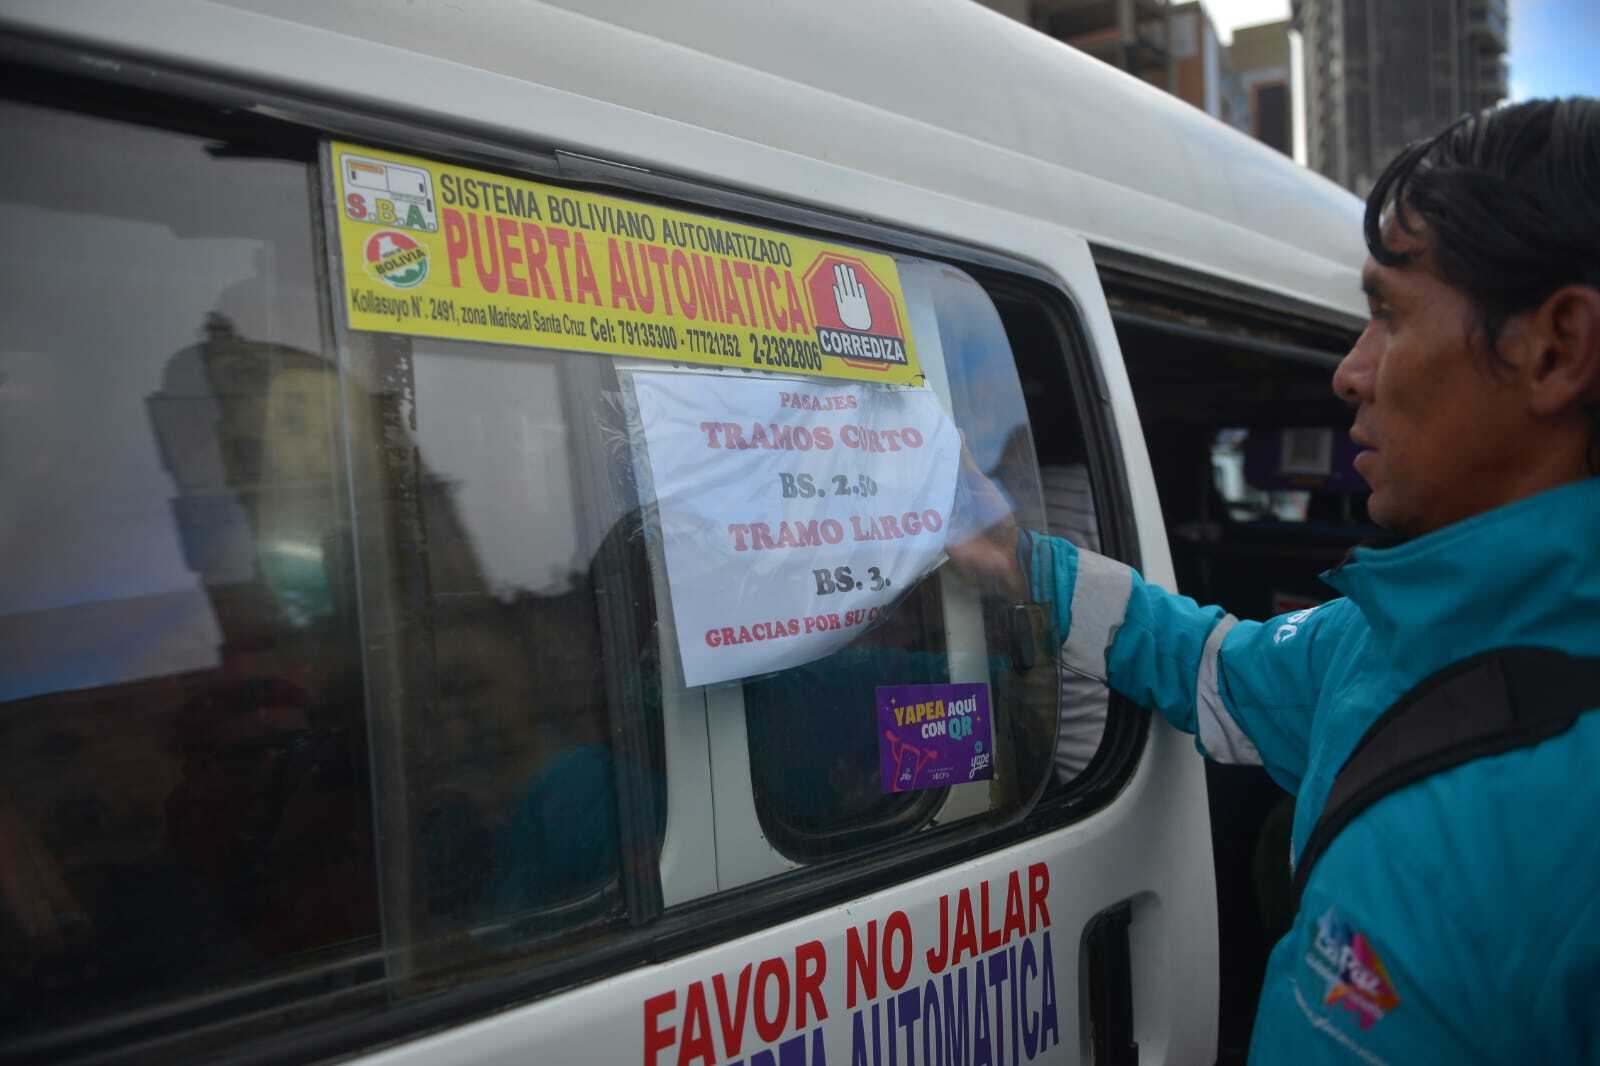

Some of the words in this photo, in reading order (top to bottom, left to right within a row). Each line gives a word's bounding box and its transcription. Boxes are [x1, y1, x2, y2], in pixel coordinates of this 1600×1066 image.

[440, 173, 542, 221] SISTEMA
[546, 194, 655, 241] BOLIVIANO
[662, 218, 793, 268] AUTOMATIZADO
[375, 248, 426, 274] BOLIVIA
[442, 207, 602, 307] PUERTA
[607, 236, 809, 336] AUTOMATICA
[461, 306, 487, 326] zona
[488, 304, 532, 331] Mariscal
[532, 310, 562, 334] Santa
[562, 313, 587, 337] Cruz
[590, 316, 617, 344] Cel:
[618, 319, 678, 351] 79135300
[686, 328, 742, 358] 77721252
[749, 333, 822, 371] 2-2382806
[820, 329, 906, 362] CORREDIZA
[778, 391, 858, 411] PASAJES
[700, 421, 834, 452] TRAMOS
[840, 424, 924, 453] CORTO
[779, 472, 826, 499] BS.
[728, 518, 844, 552] TRAMO
[849, 508, 943, 542] LARGO
[812, 566, 863, 596] BS.
[705, 618, 800, 648] GRACIAS
[803, 612, 841, 634] POR
[844, 608, 866, 628] SU
[894, 700, 945, 726] YAPEA
[947, 694, 977, 717] AQUÍ
[921, 720, 946, 739] CON
[948, 715, 973, 741] QR
[643, 938, 829, 1066] FAVOR
[846, 910, 914, 1010] NO
[926, 861, 1051, 974] JALAR
